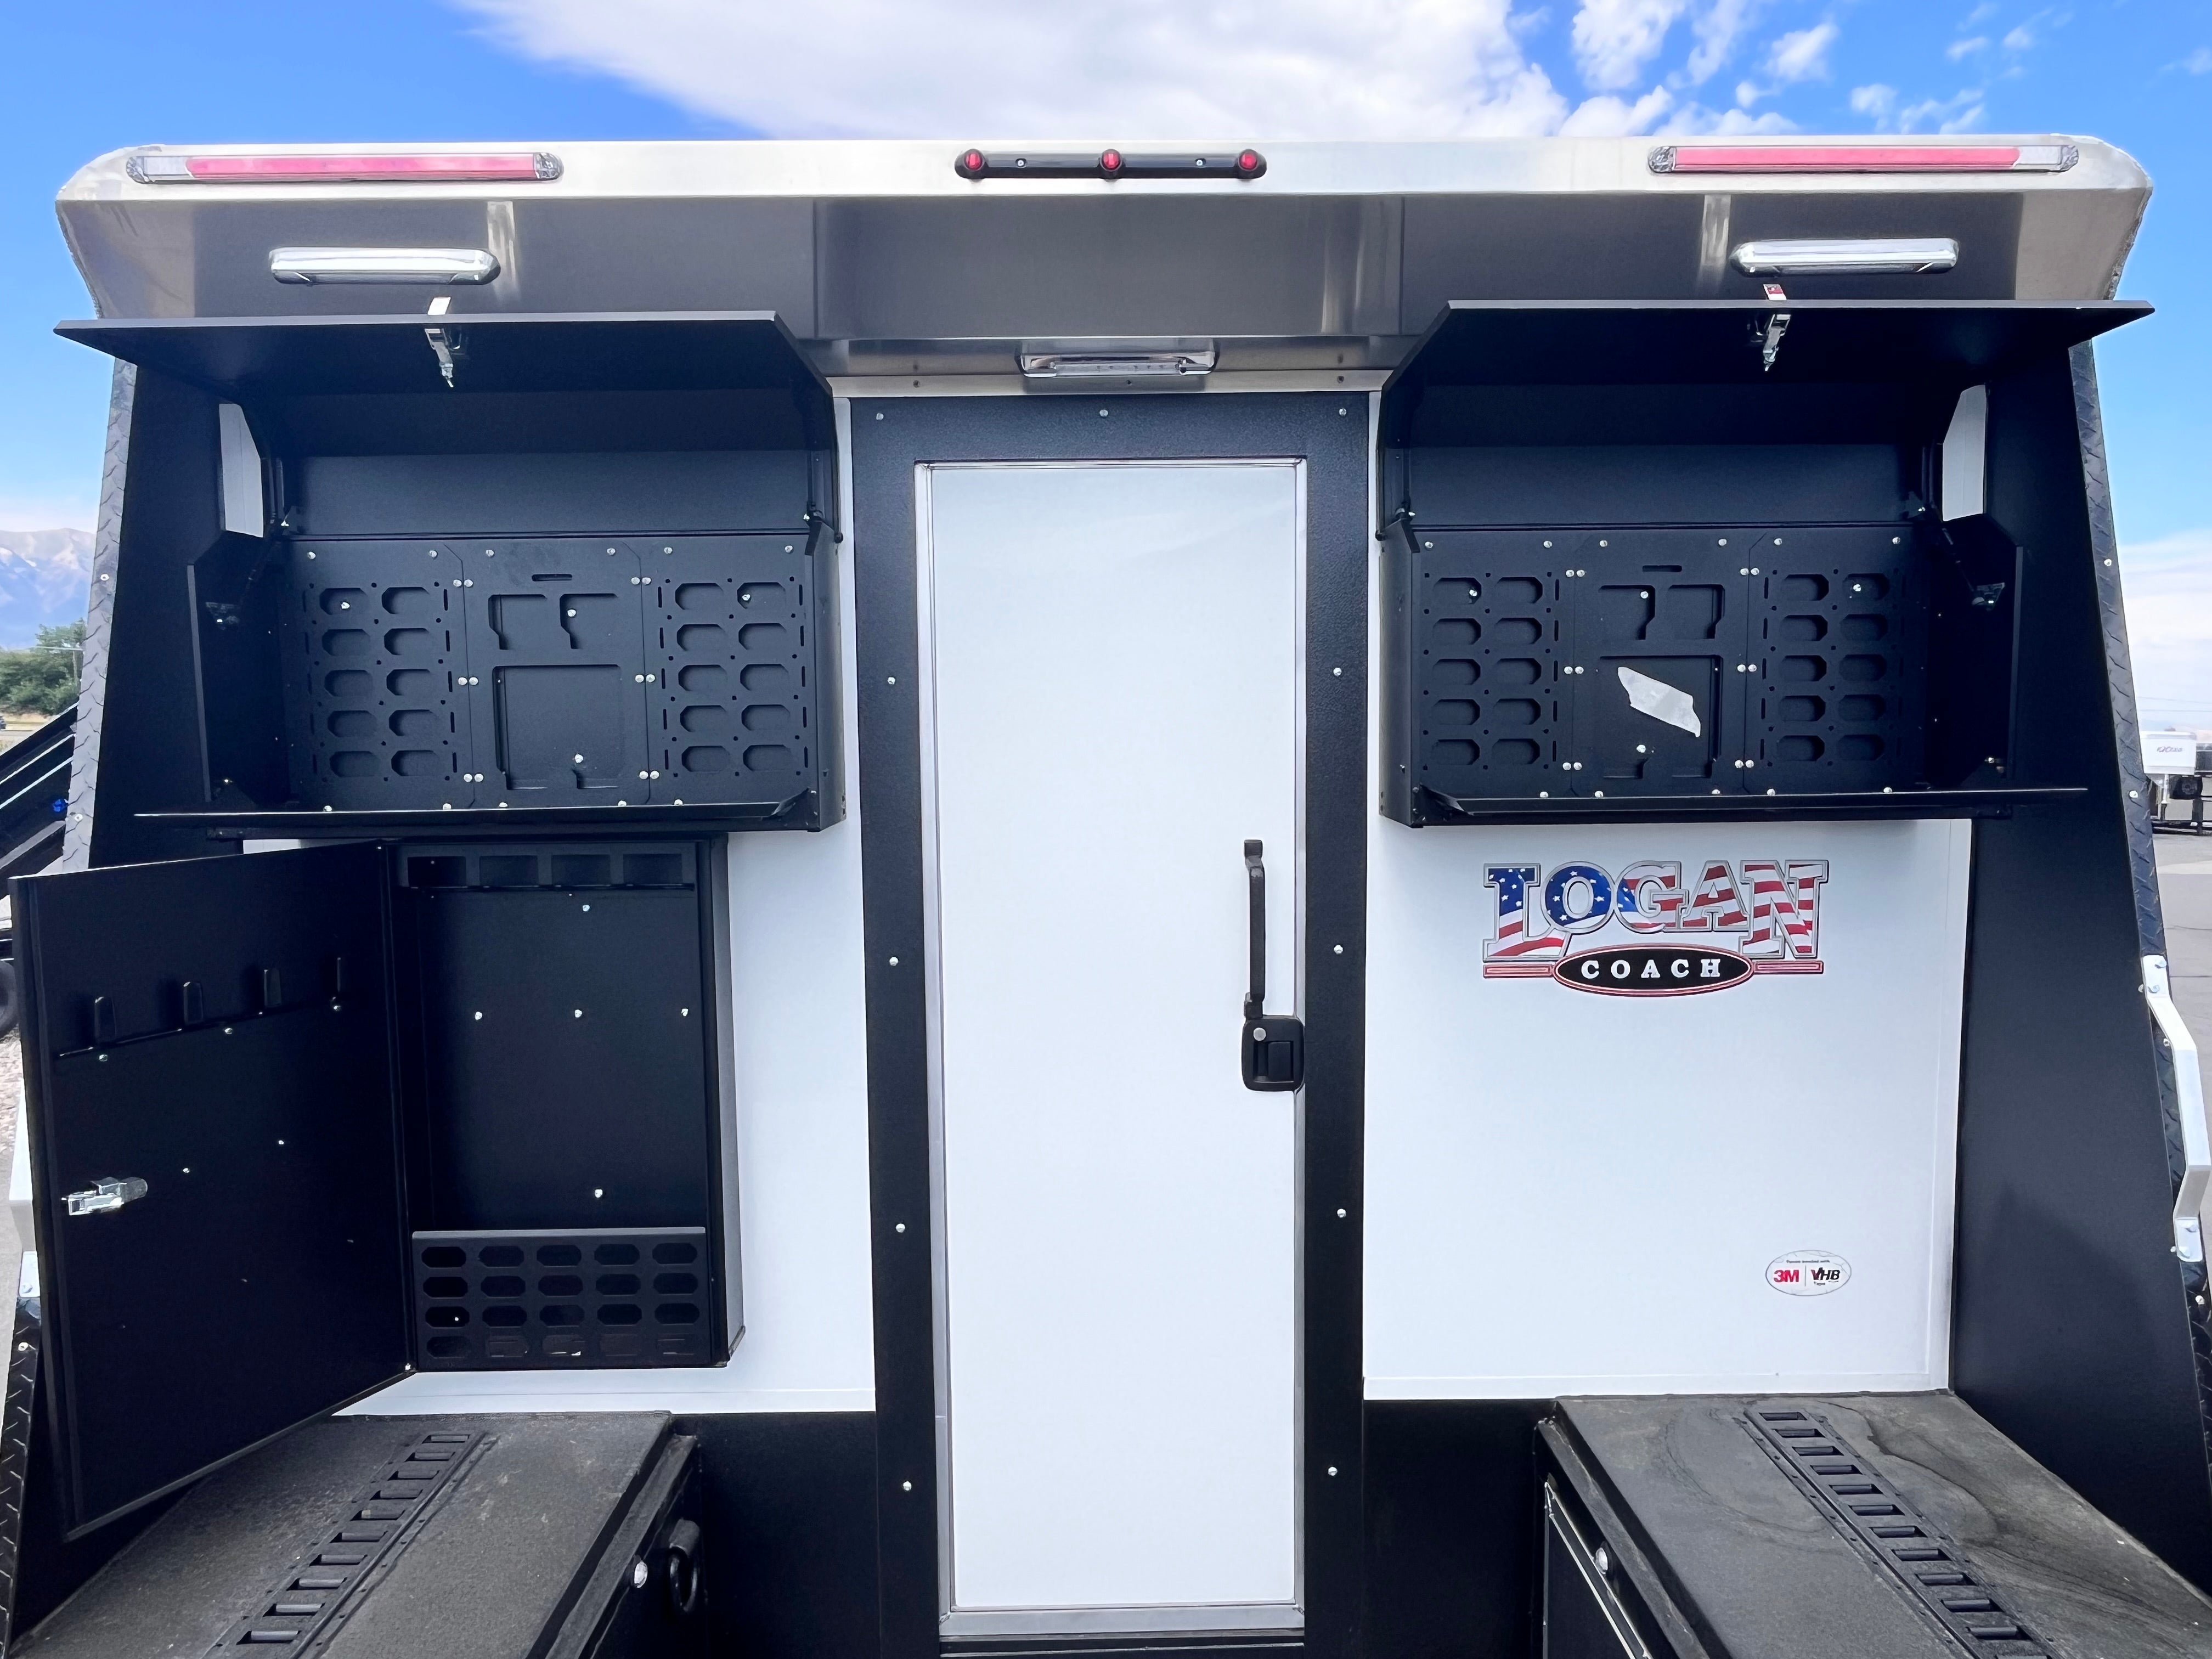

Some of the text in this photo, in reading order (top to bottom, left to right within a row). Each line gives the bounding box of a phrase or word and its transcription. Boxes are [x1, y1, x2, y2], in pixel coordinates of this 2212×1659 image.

[1483, 860, 1829, 962] LOGAN
[1581, 958, 1721, 979] COACH
[1773, 1267, 1841, 1283] 3M VHB
